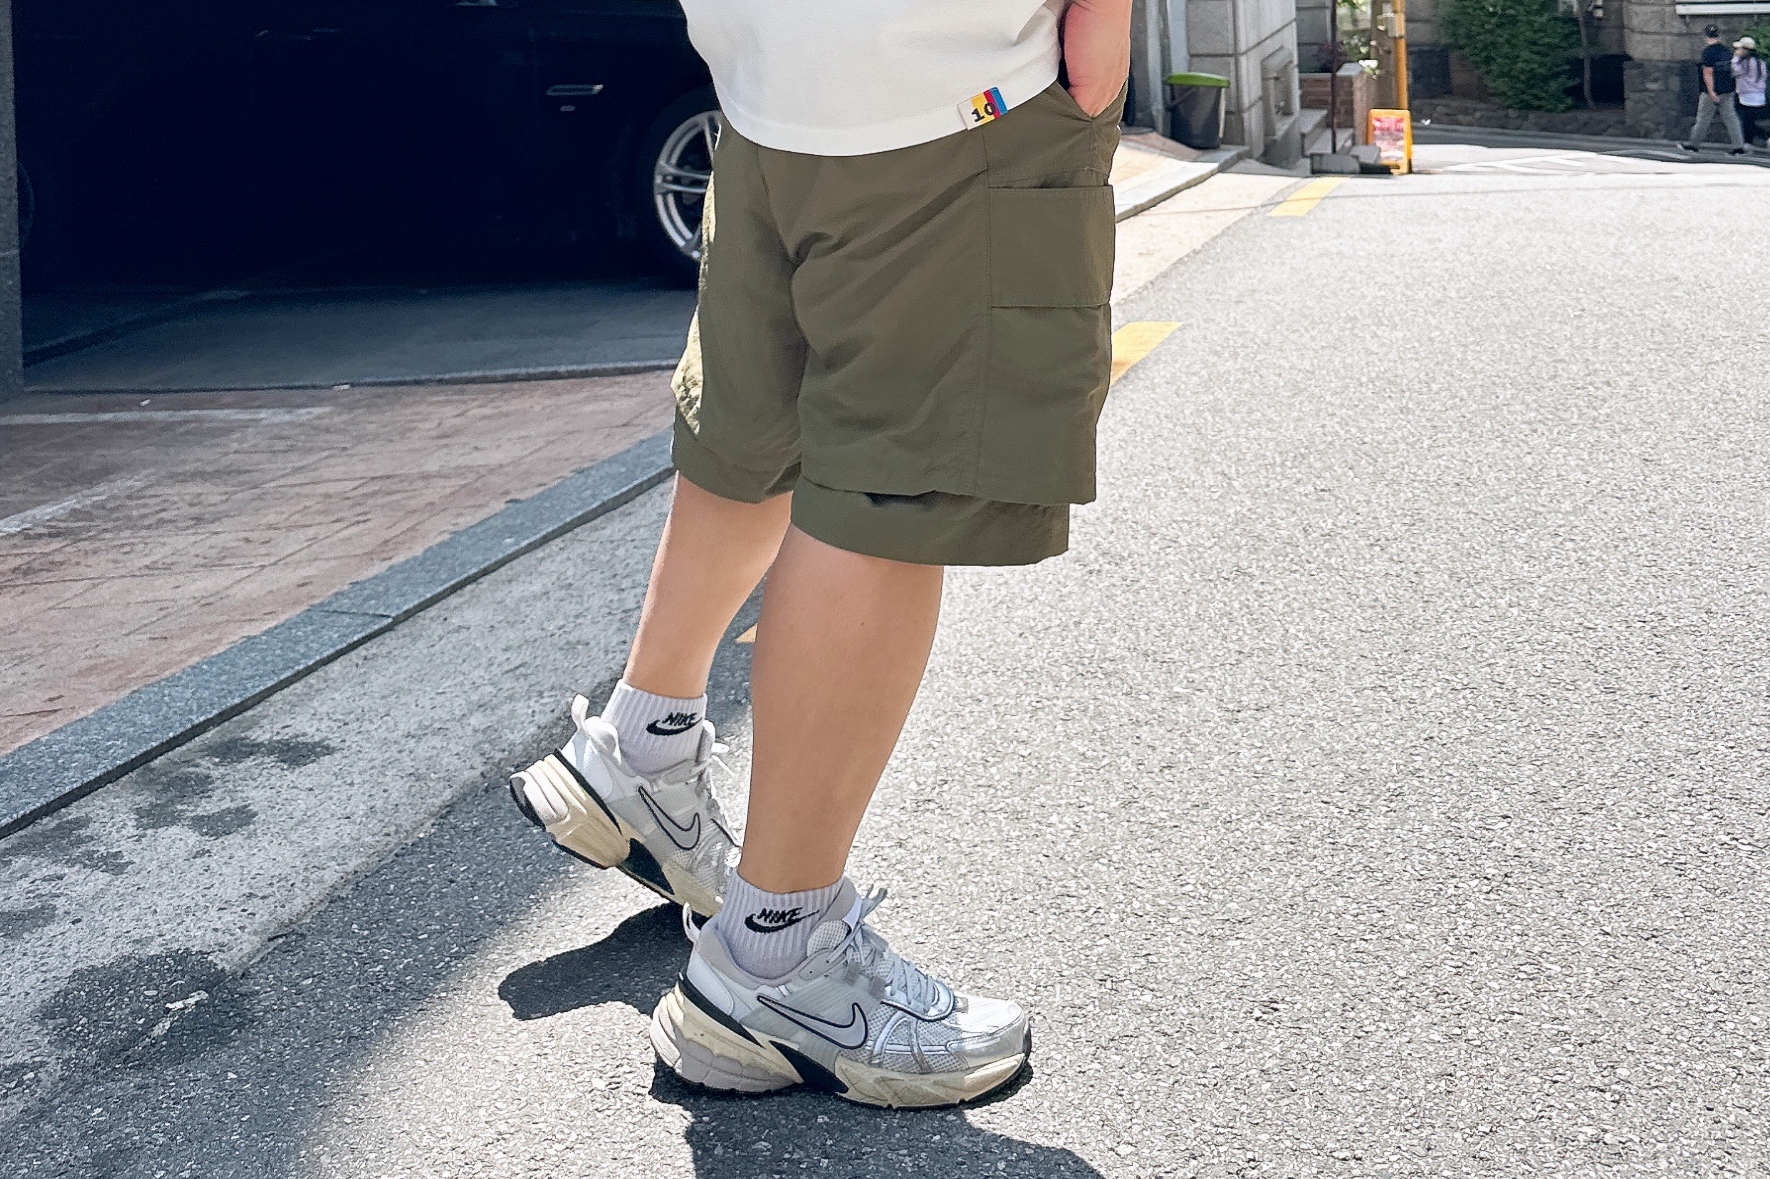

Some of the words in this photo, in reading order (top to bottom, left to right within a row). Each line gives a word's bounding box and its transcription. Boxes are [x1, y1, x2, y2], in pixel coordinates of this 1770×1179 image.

[971, 102, 996, 123] 10
[662, 712, 697, 726] NIKE
[757, 907, 803, 923] NIKE
